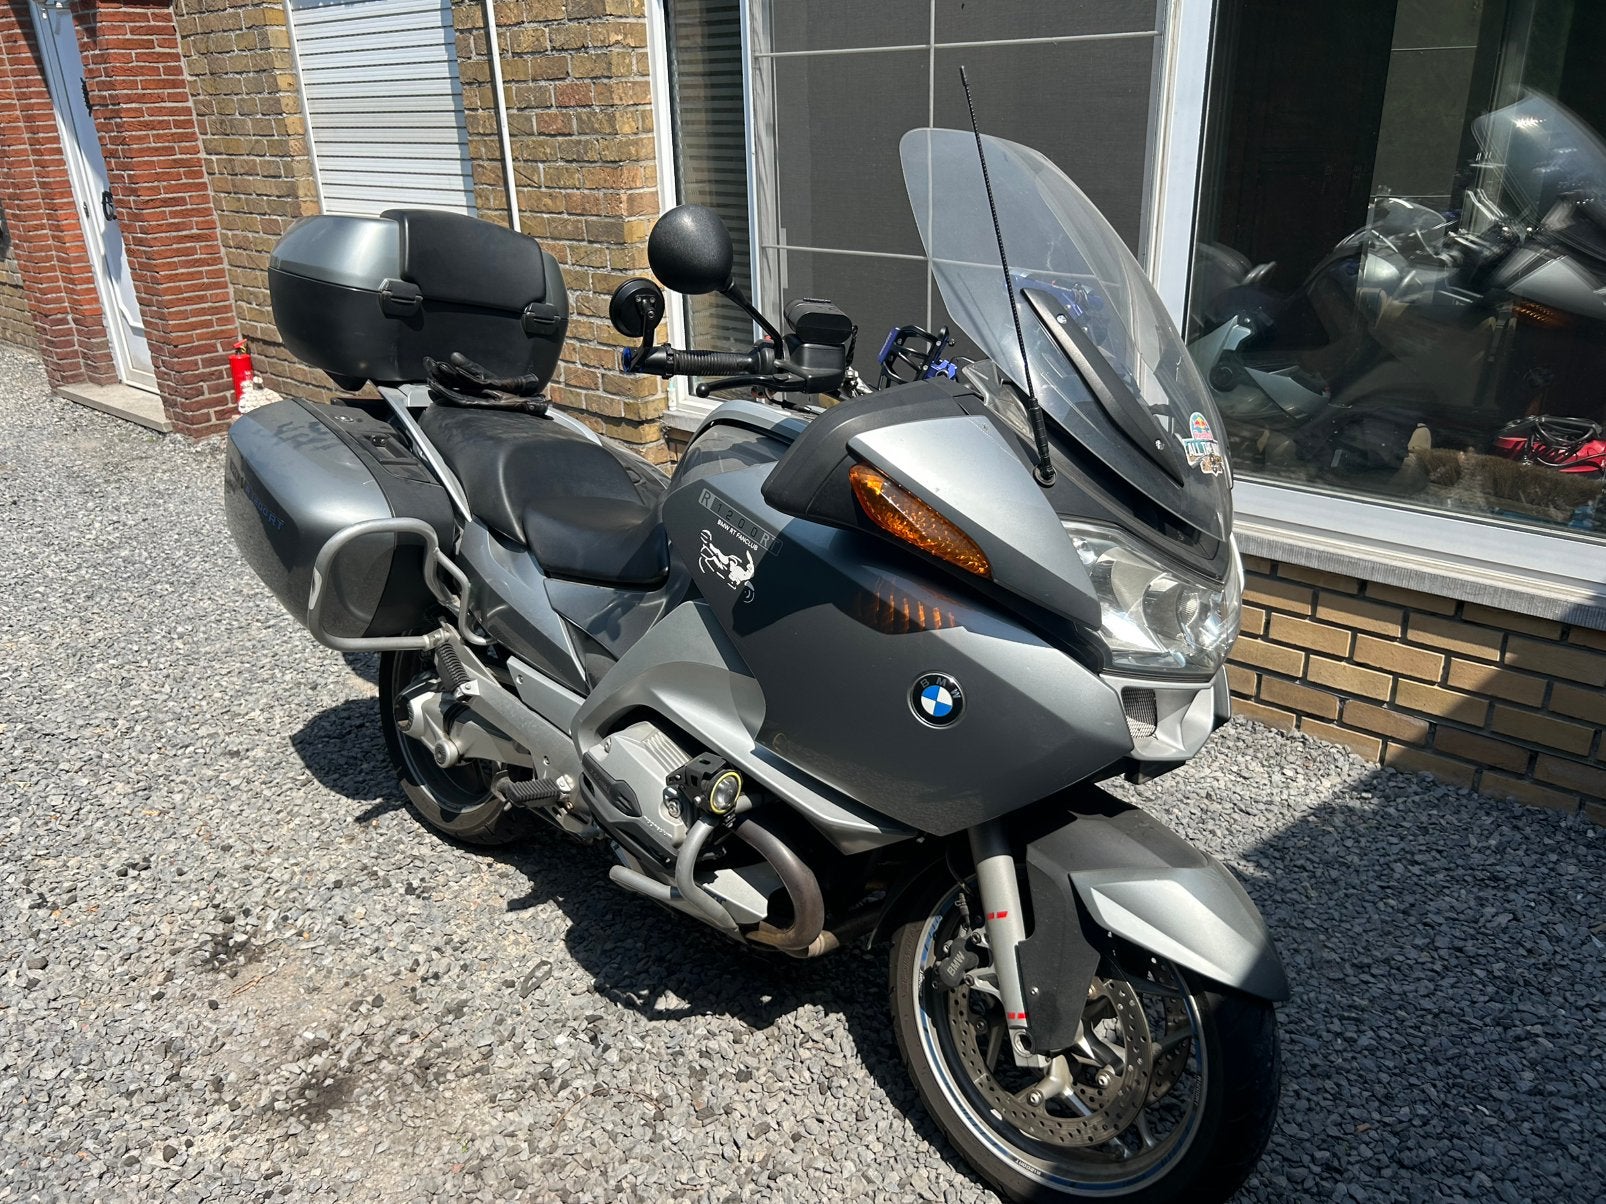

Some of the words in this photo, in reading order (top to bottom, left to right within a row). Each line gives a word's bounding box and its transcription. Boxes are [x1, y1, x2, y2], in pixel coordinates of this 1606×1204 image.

[716, 519, 731, 532] BMW
[729, 527, 737, 536] RT
[735, 532, 759, 551] FANCLUB
[919, 676, 961, 699] BMW
[946, 950, 966, 977] BMW
